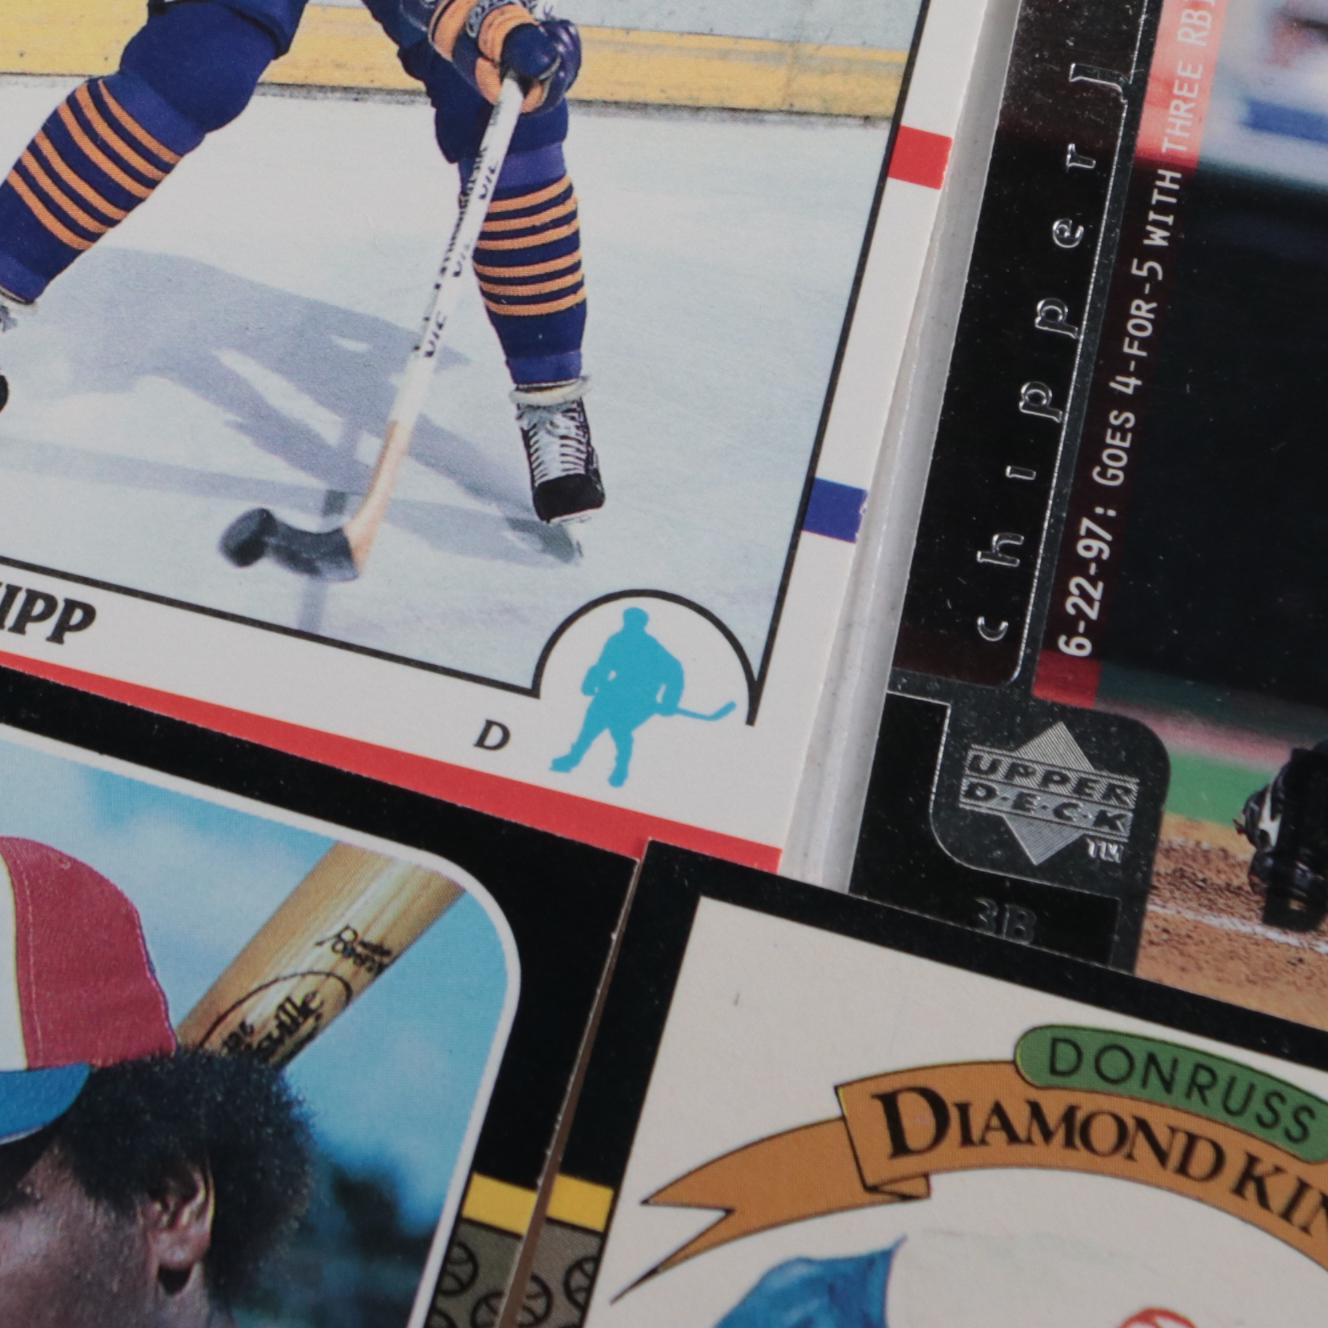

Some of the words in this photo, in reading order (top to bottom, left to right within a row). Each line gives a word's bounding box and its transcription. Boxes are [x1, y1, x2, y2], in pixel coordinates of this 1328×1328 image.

[1162, 61, 1204, 154] THREE
[1143, 169, 1183, 247] WITH
[1109, 257, 1164, 395] 4-FOR-5
[1092, 409, 1136, 487] GOES
[1058, 506, 1117, 657] 6-22-97:
[473, 719, 511, 751] D
[969, 753, 1135, 809] UPPER
[974, 896, 1037, 945] 3B
[1049, 1037, 1317, 1145] DONRUSS
